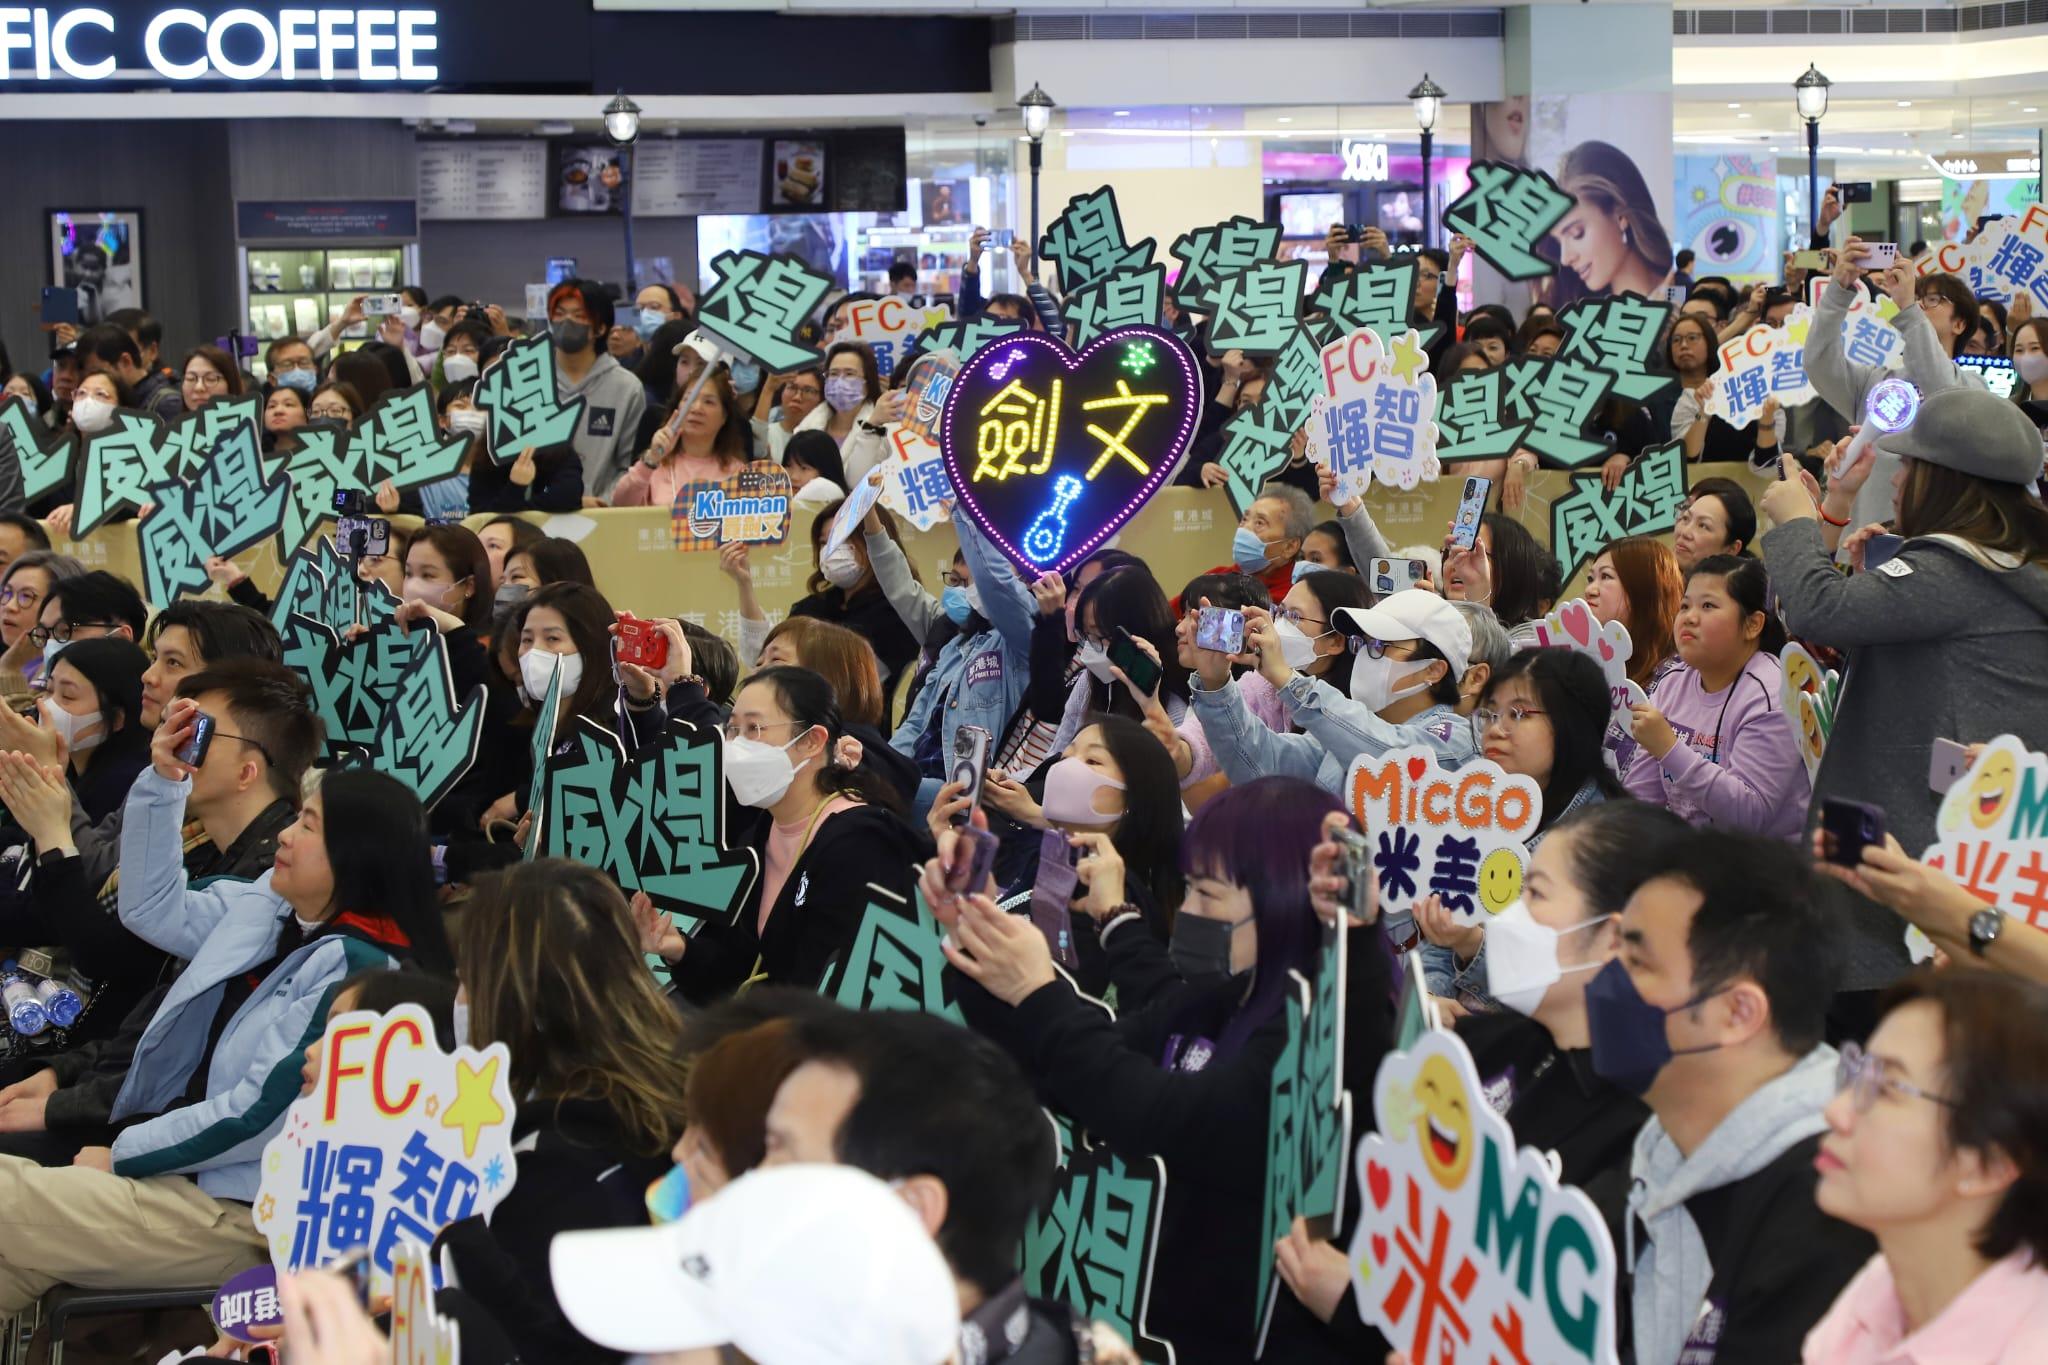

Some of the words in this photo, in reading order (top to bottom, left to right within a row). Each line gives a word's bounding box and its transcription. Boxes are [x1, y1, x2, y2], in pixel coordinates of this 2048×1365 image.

[0, 8, 117, 80] FIC
[144, 8, 438, 81] COFFEE
[1448, 165, 1574, 280] 煌
[699, 255, 830, 371] 煌
[852, 301, 906, 336] FC
[1203, 263, 1302, 350] 煌
[1562, 297, 1673, 400] 煌
[1722, 328, 1772, 373] FC
[477, 338, 582, 458] 煌
[1323, 333, 1376, 398] FC
[1505, 358, 1609, 465] 煌
[1324, 383, 1420, 476] 輝智
[696, 490, 786, 519] Kimman
[551, 731, 749, 912] 威煌
[325, 1020, 422, 1121] FC
